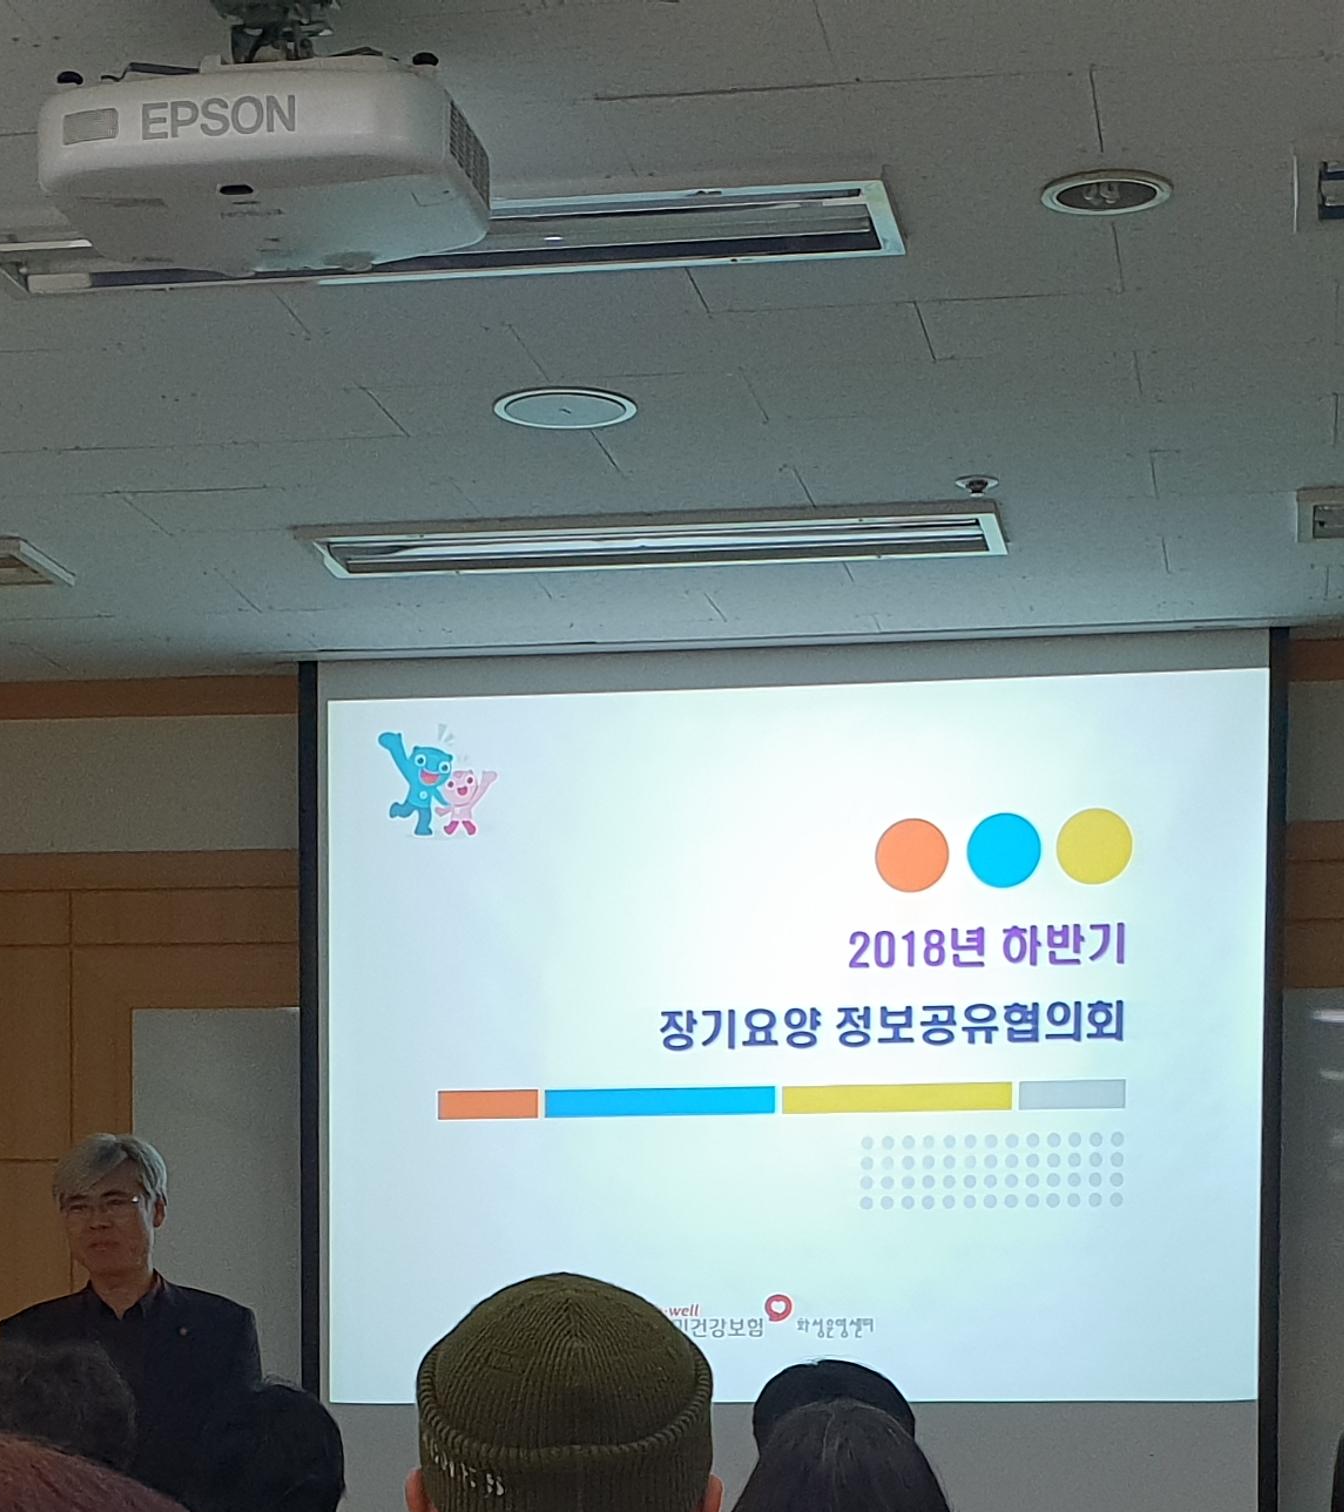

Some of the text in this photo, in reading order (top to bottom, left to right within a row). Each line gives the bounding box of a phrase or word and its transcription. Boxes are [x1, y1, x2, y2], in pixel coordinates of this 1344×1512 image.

[141, 94, 297, 141] EPSON
[848, 922, 1126, 969] 2018년 하반기
[659, 1000, 1124, 1051] 장기요양 정보공유협의회
